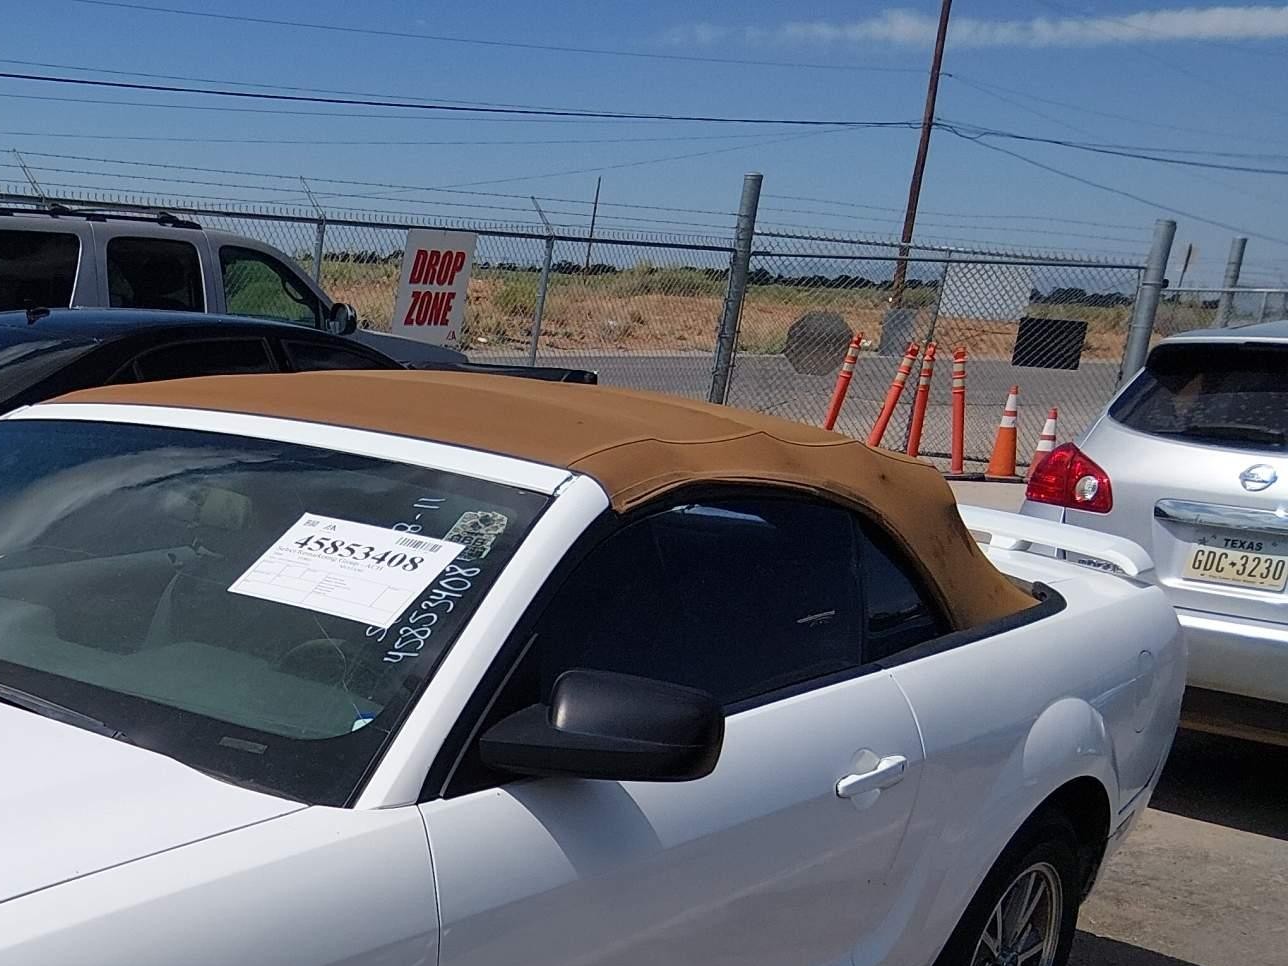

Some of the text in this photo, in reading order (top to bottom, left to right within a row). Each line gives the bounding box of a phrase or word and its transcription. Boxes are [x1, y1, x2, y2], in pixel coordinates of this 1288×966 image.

[409, 249, 466, 286] DROP
[404, 290, 456, 326] ZONE
[294, 534, 425, 573] 45853408
[1224, 538, 1264, 552] TEXAS
[383, 564, 481, 663] 45853408
